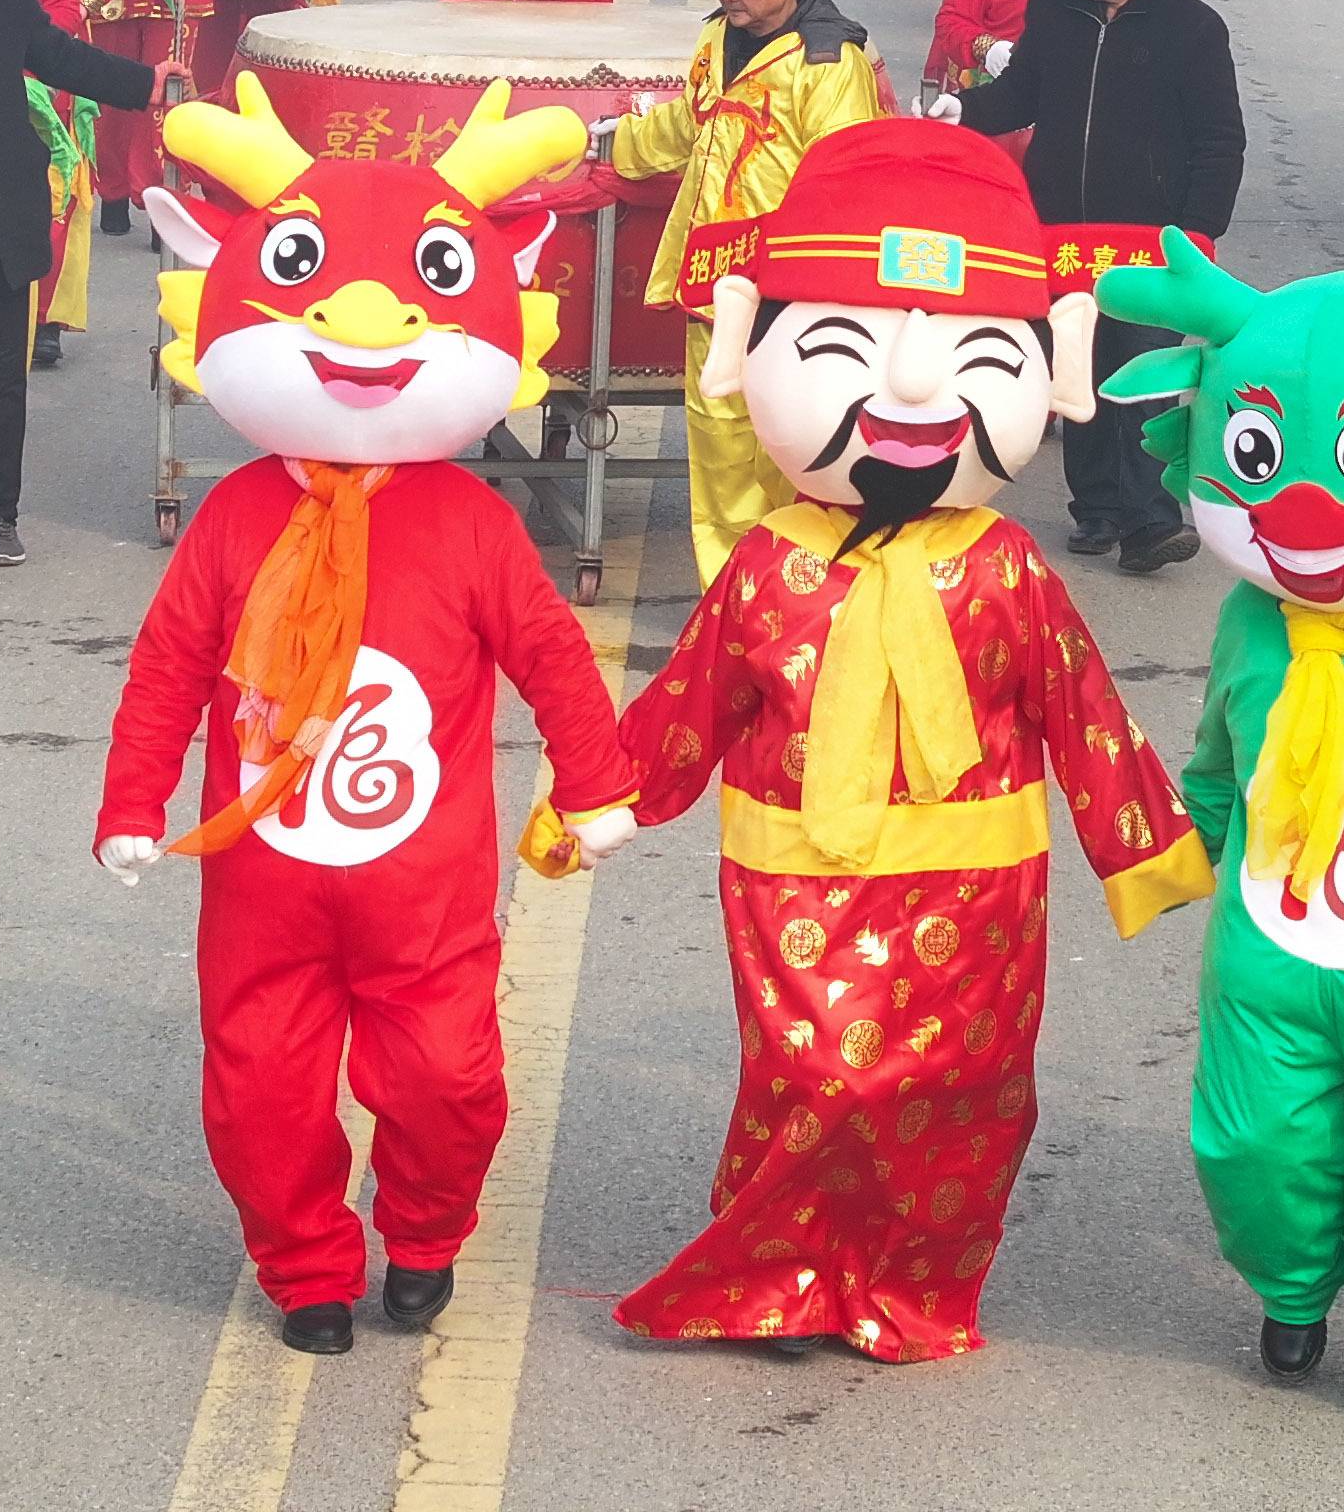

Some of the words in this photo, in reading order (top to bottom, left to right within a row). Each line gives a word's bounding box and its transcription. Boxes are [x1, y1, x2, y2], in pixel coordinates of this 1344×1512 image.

[686, 225, 762, 285] 招财进宝
[898, 234, 952, 285] 發
